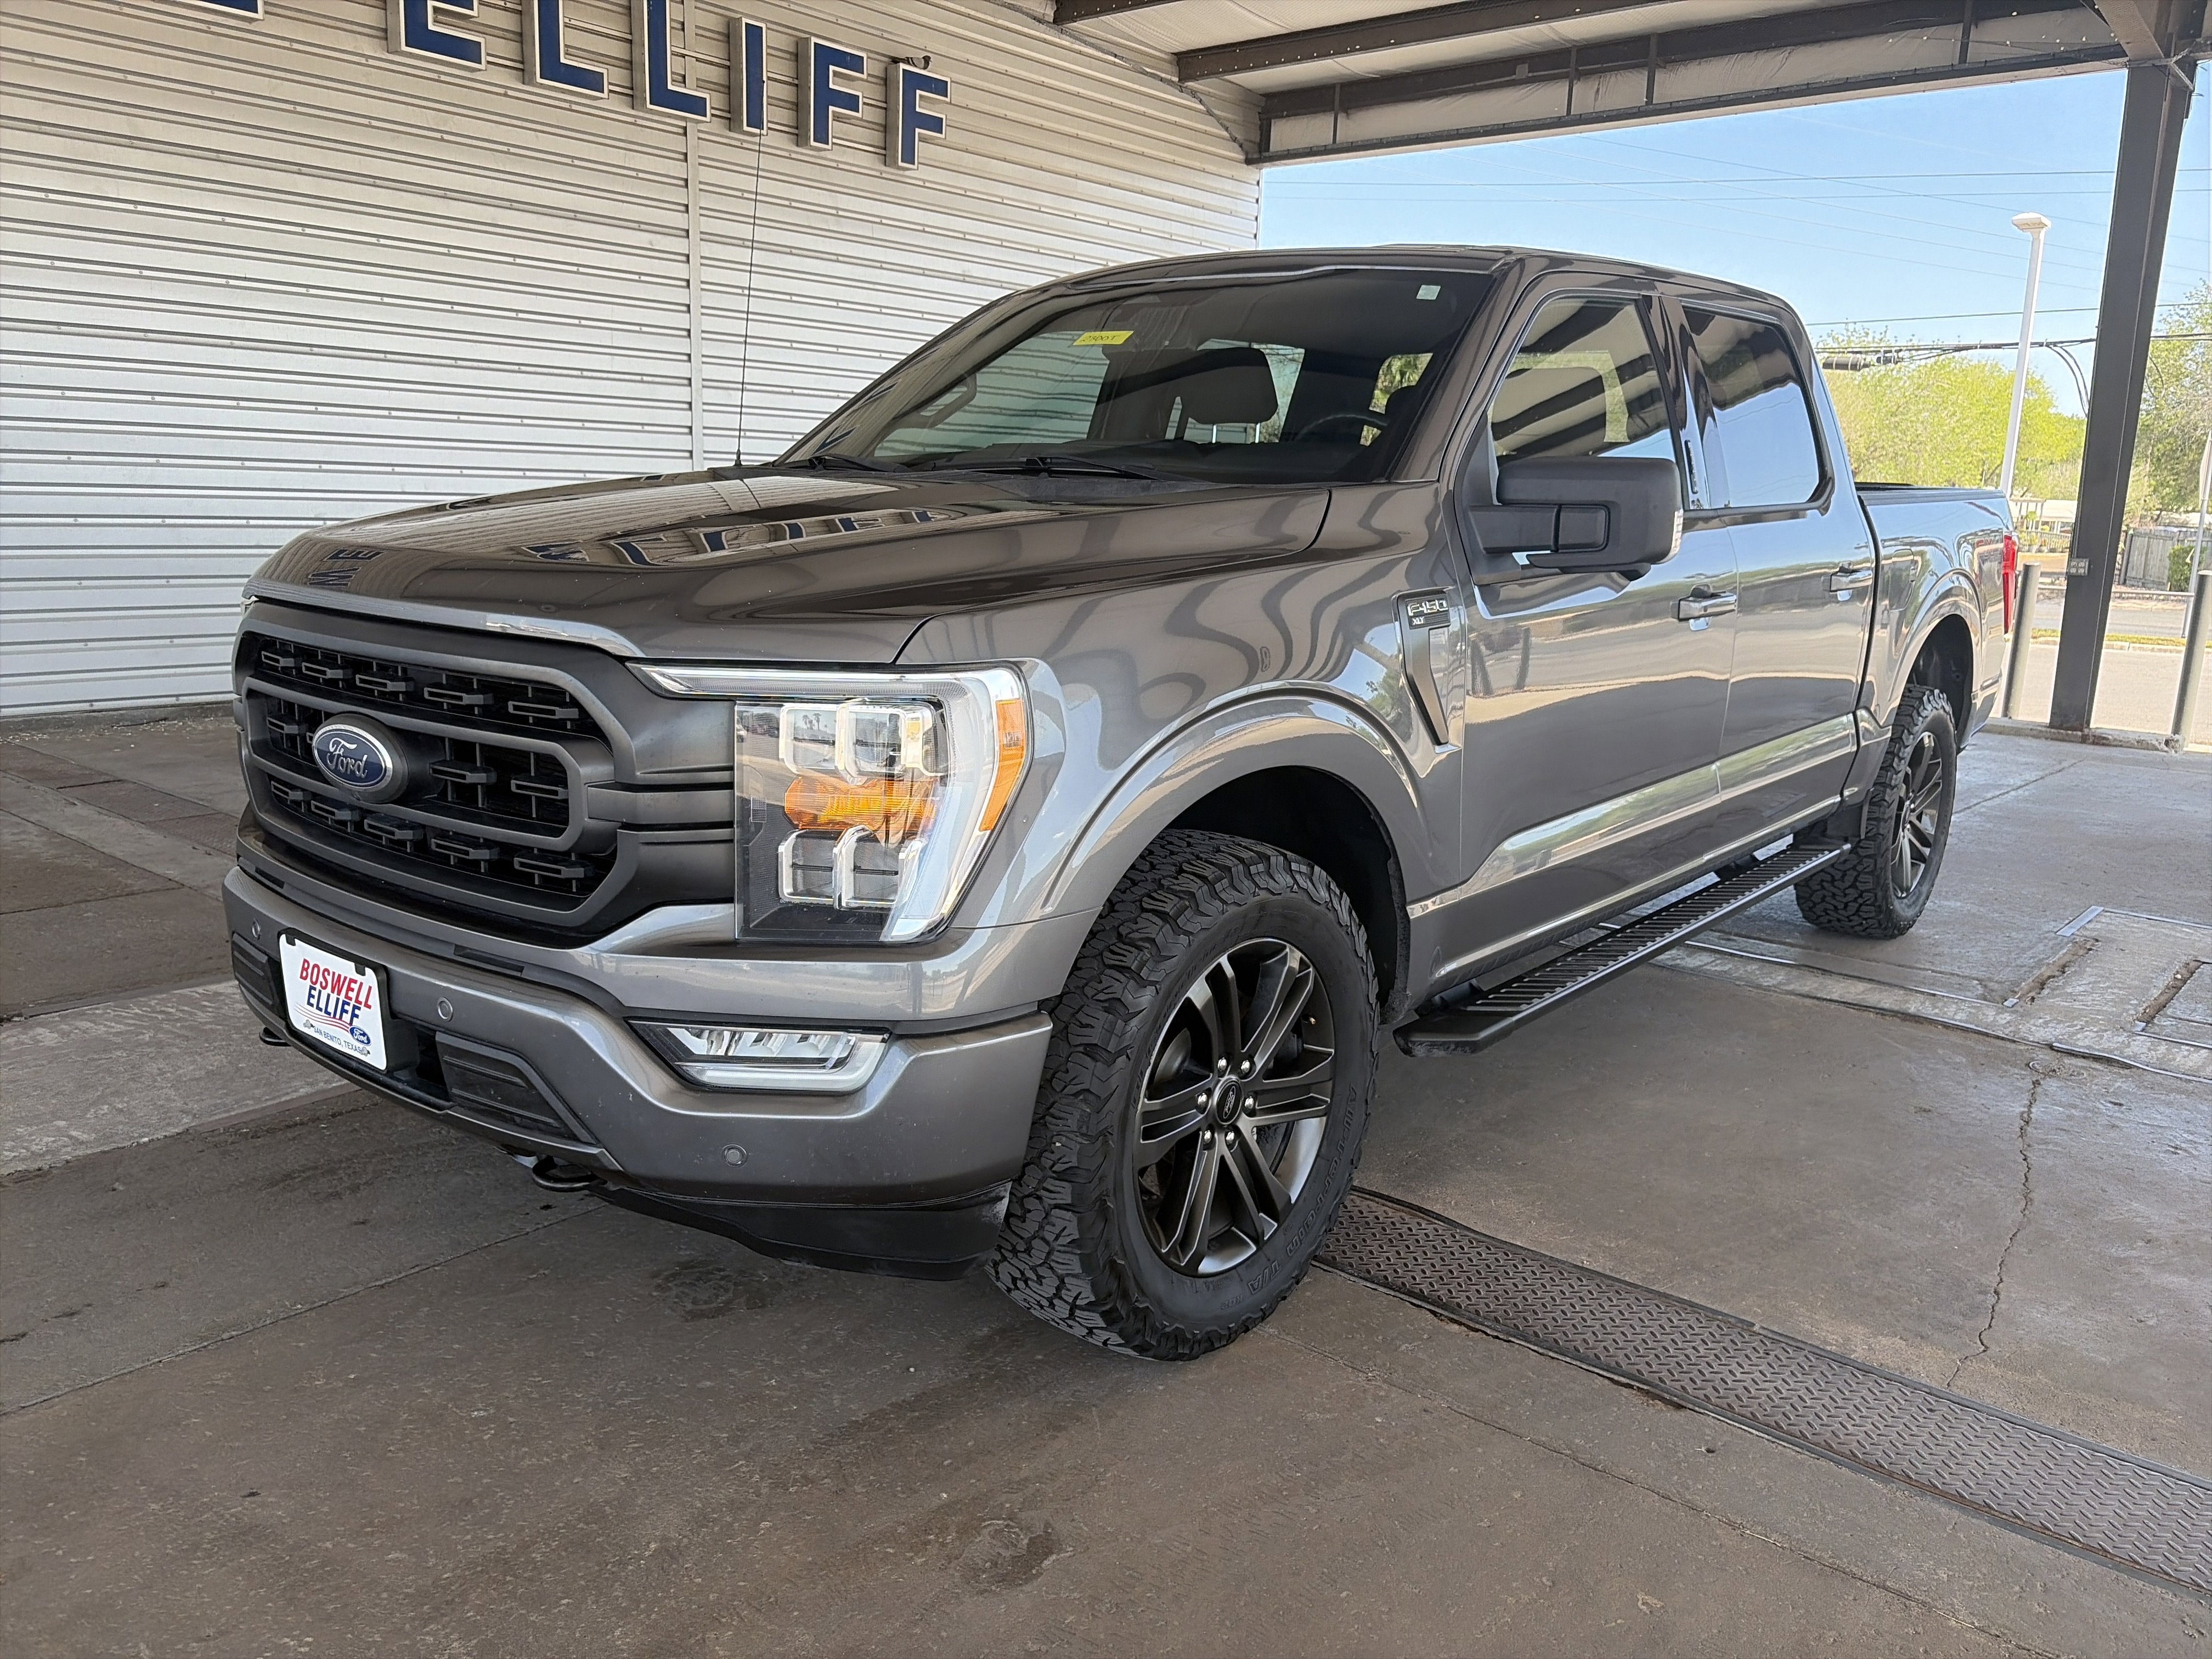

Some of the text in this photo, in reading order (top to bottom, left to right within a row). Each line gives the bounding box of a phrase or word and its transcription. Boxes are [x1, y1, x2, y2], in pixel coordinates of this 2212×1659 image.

[1407, 599, 1448, 616] F-150
[1412, 617, 1425, 625] XLT
[326, 737, 368, 778] Ford
[300, 957, 373, 1009] BOSWELL
[306, 984, 362, 1026] ELLIFF
[314, 1025, 362, 1053] SAN BENITO, TEXAS
[353, 1028, 368, 1044] Ford
[1247, 1259, 1282, 1295] T/A
